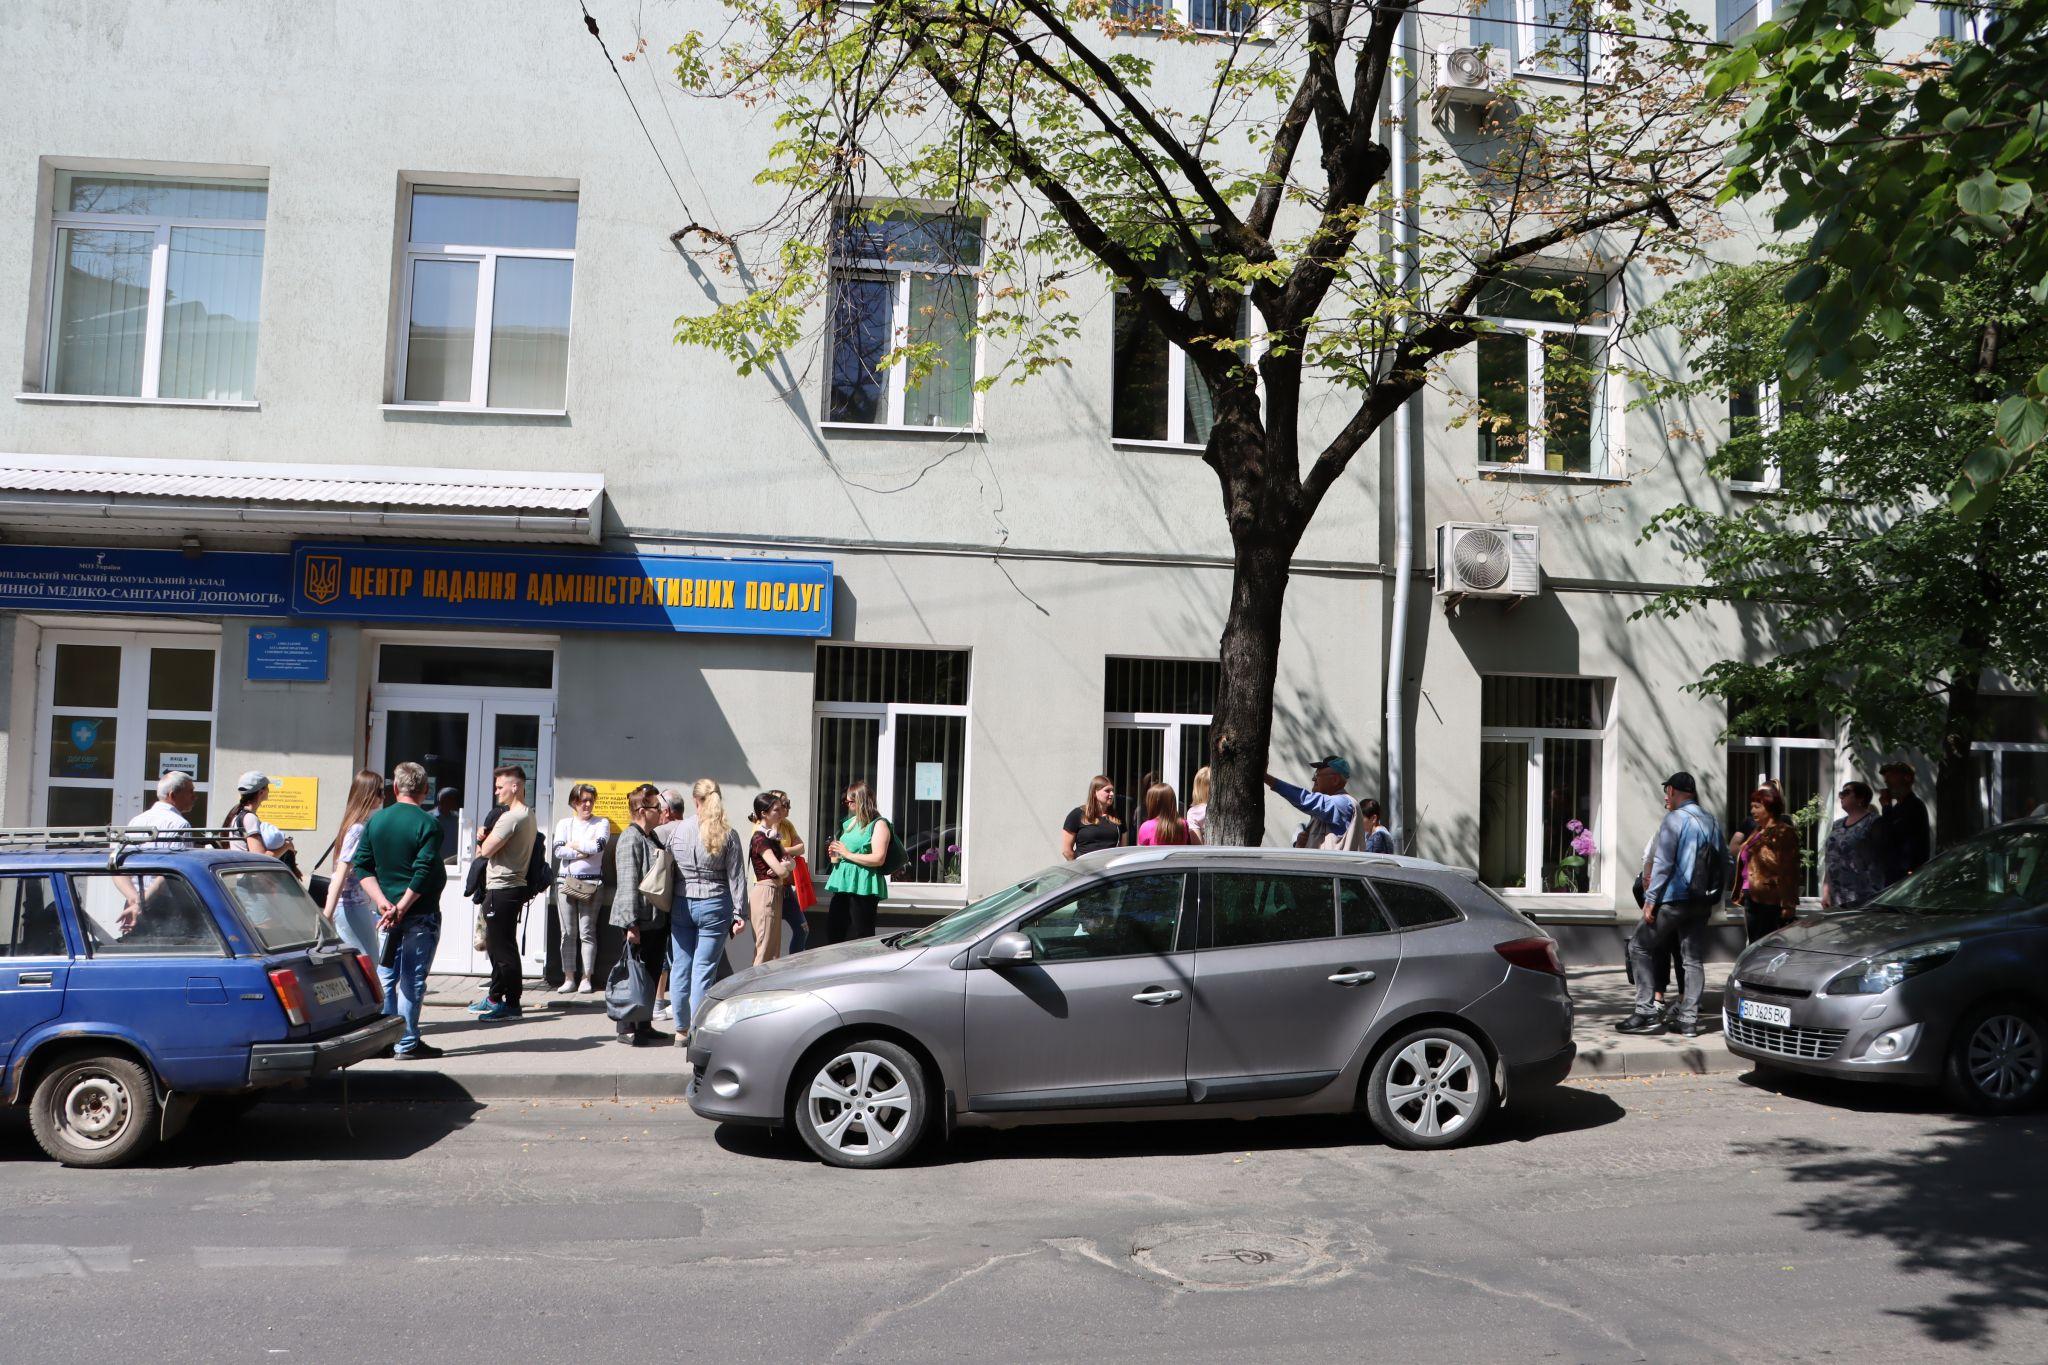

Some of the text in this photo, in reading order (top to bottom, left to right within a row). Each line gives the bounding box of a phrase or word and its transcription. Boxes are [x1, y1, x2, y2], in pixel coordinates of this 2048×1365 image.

[62, 573, 108, 583] МІСЬКИЙ
[109, 576, 185, 585] КОМУНАЛЬНИЙ
[188, 578, 225, 587] ЗАКЛАД
[47, 586, 196, 601] МЕДИКО-САНІТАРНОЇ
[198, 591, 286, 604] ДОПОМОГИ»
[349, 567, 826, 612] ЦЕНТР НАДАННЯ АДМІНІСТРАТИВНИХ ПОСЛУГ
